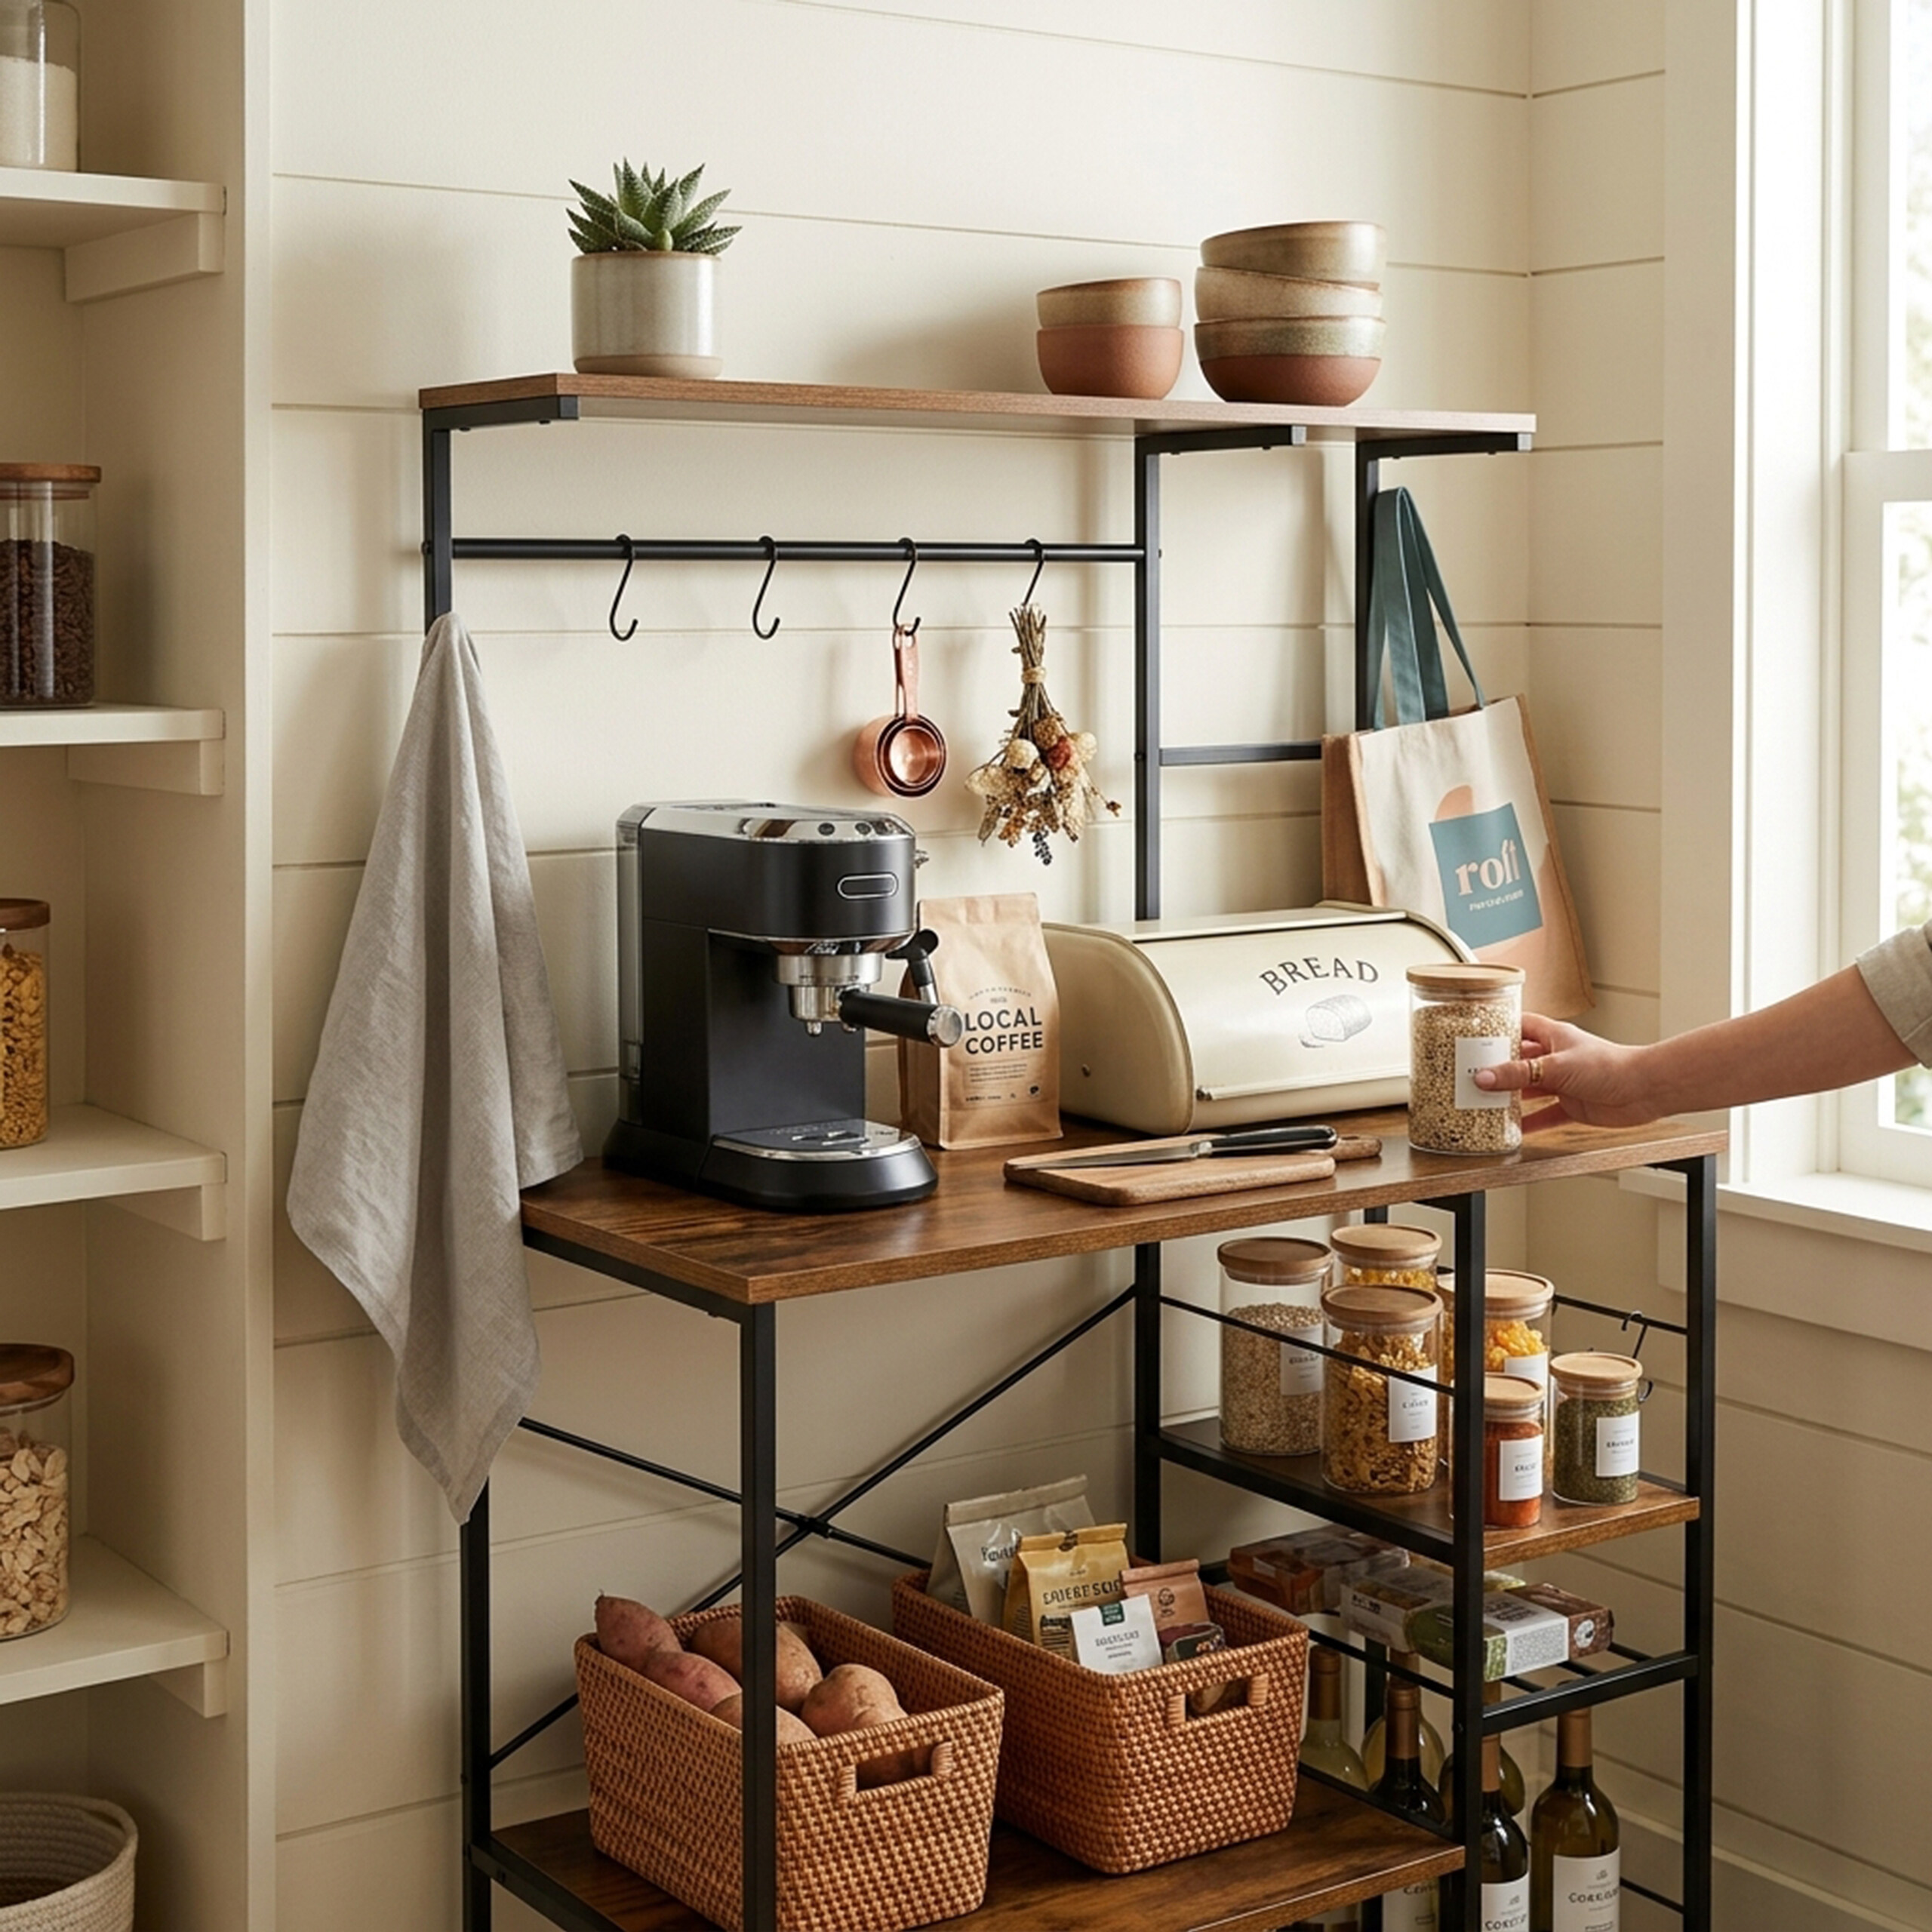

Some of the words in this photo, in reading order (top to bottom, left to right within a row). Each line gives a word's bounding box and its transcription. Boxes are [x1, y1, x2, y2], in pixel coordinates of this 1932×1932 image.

[1259, 956, 1379, 995] BREAD
[964, 1006, 1043, 1032] LOCAL
[964, 1031, 1044, 1055] COFFEE
